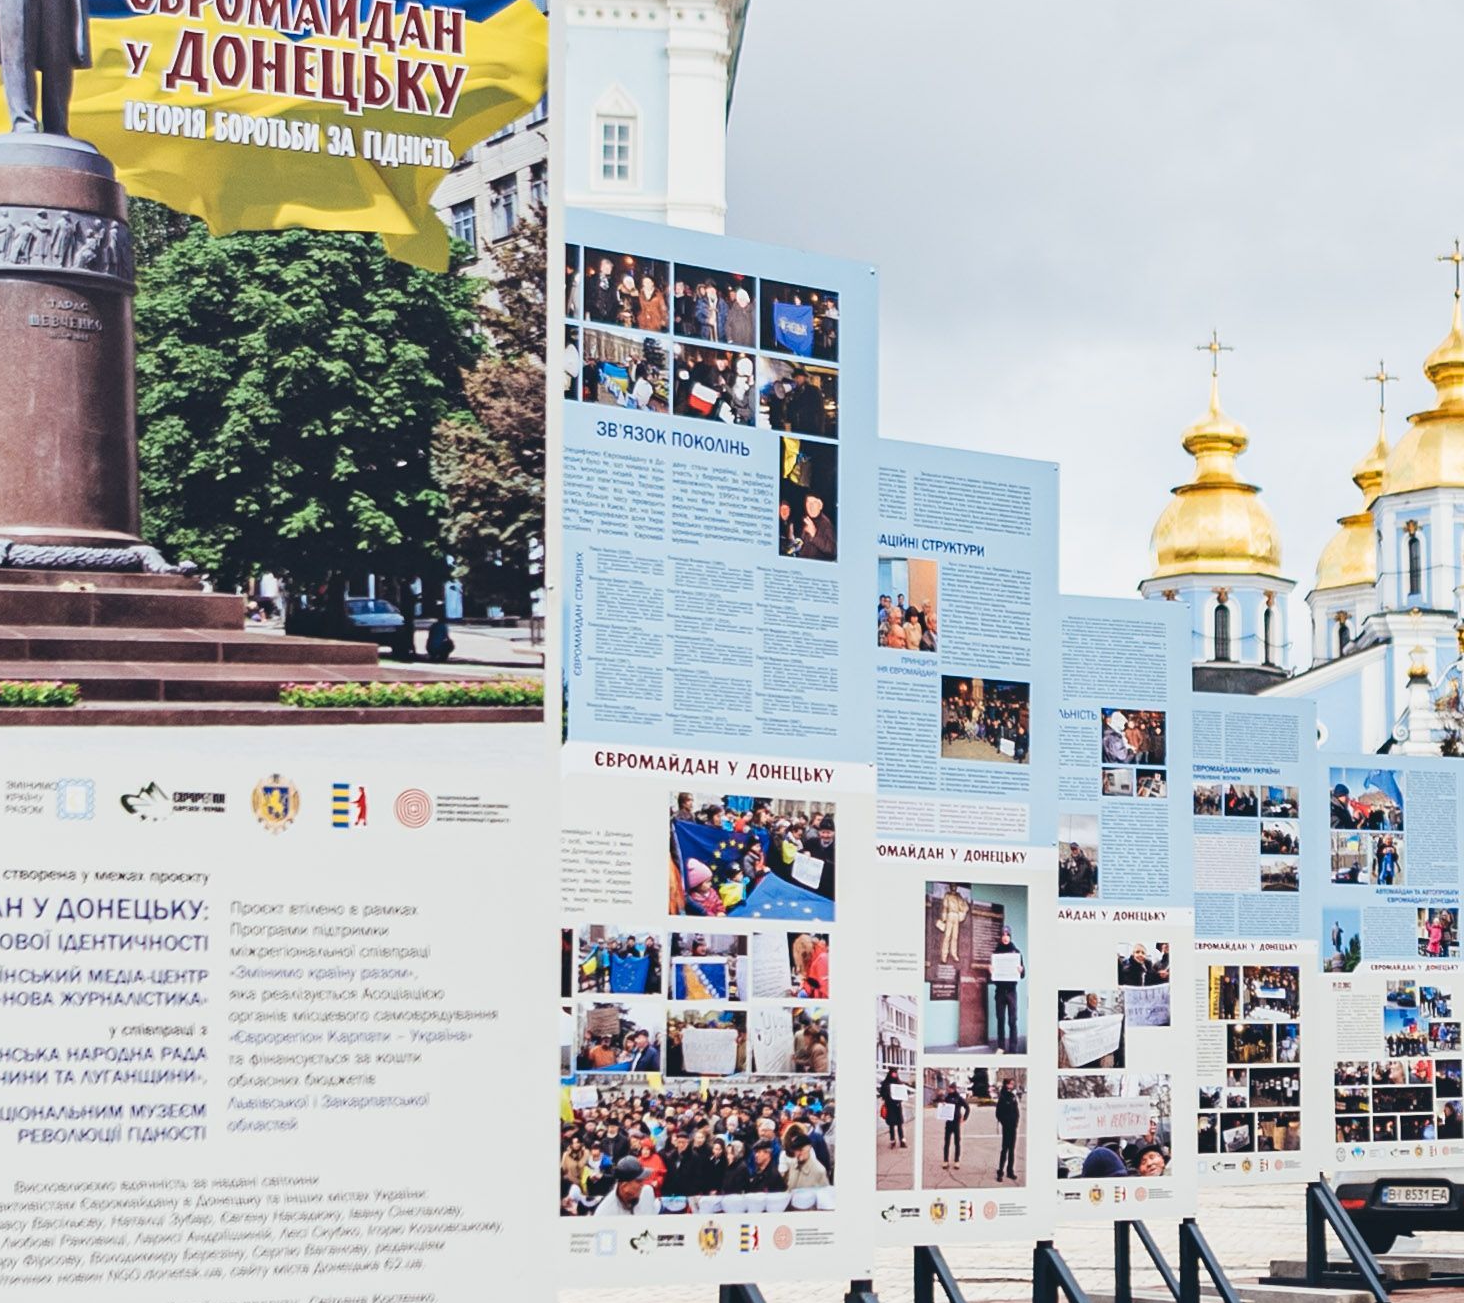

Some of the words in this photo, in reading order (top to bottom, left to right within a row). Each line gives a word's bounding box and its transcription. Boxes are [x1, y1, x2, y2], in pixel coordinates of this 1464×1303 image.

[125, 41, 150, 77] У
[163, 30, 468, 116] ДОНЕЦЬКУ
[124, 102, 207, 140] ІСТОРІЯ
[214, 112, 320, 153] БОРОТЬБИ
[328, 126, 355, 158] ЗА
[363, 130, 456, 169] ГІДНІСТЬ
[672, 432, 750, 457] ПОКОЛІНЬ
[922, 539, 985, 558] СТРУКТУРИ
[575, 552, 584, 601] СТАРШИХ
[573, 604, 584, 677] ЄВРОМАЙДАН
[594, 751, 720, 776] ЄВРОМАЙДАН
[728, 760, 738, 777] У
[746, 762, 835, 784] ДОНЕЦЬКУ
[951, 848, 958, 860] У
[964, 850, 1027, 864] ДОНЕЦЬКУ
[3, 868, 76, 882] створена
[81, 871, 89, 883] у
[95, 870, 143, 881] межах
[34, 897, 51, 918] У
[56, 897, 210, 923] ДОНЕЦЬКУ:
[363, 905, 418, 917] рамках
[1113, 911, 1167, 922] ДОНЕЦЬКУ
[230, 922, 307, 937] Програми
[313, 923, 389, 938] підтримки
[58, 933, 209, 953] ІДЕНТИЧНОСТІ
[229, 945, 356, 959] міжрегіональної
[359, 945, 431, 959] співпраці
[88, 968, 208, 986] МЕДІА-ЦЕНТР
[308, 967, 355, 981] країну
[230, 989, 256, 1000] яка
[229, 1010, 287, 1024] органів
[293, 1009, 369, 1023] місцевого
[373, 1009, 499, 1024] самоврядування
[109, 1025, 116, 1038] у
[327, 1030, 391, 1045] Карпати
[67, 1047, 153, 1063] НАРОДНА
[160, 1047, 208, 1062] РАДА
[375, 1052, 422, 1064] кошти
[55, 1070, 76, 1085] ТА
[305, 1071, 376, 1088] бюджетів
[322, 1093, 430, 1109] Закарпатської
[18, 1125, 122, 1144] РЕВОЛЮЦІЇ
[128, 1125, 206, 1143] ГІДНОСТІ
[1405, 1188, 1429, 1201] 8531
